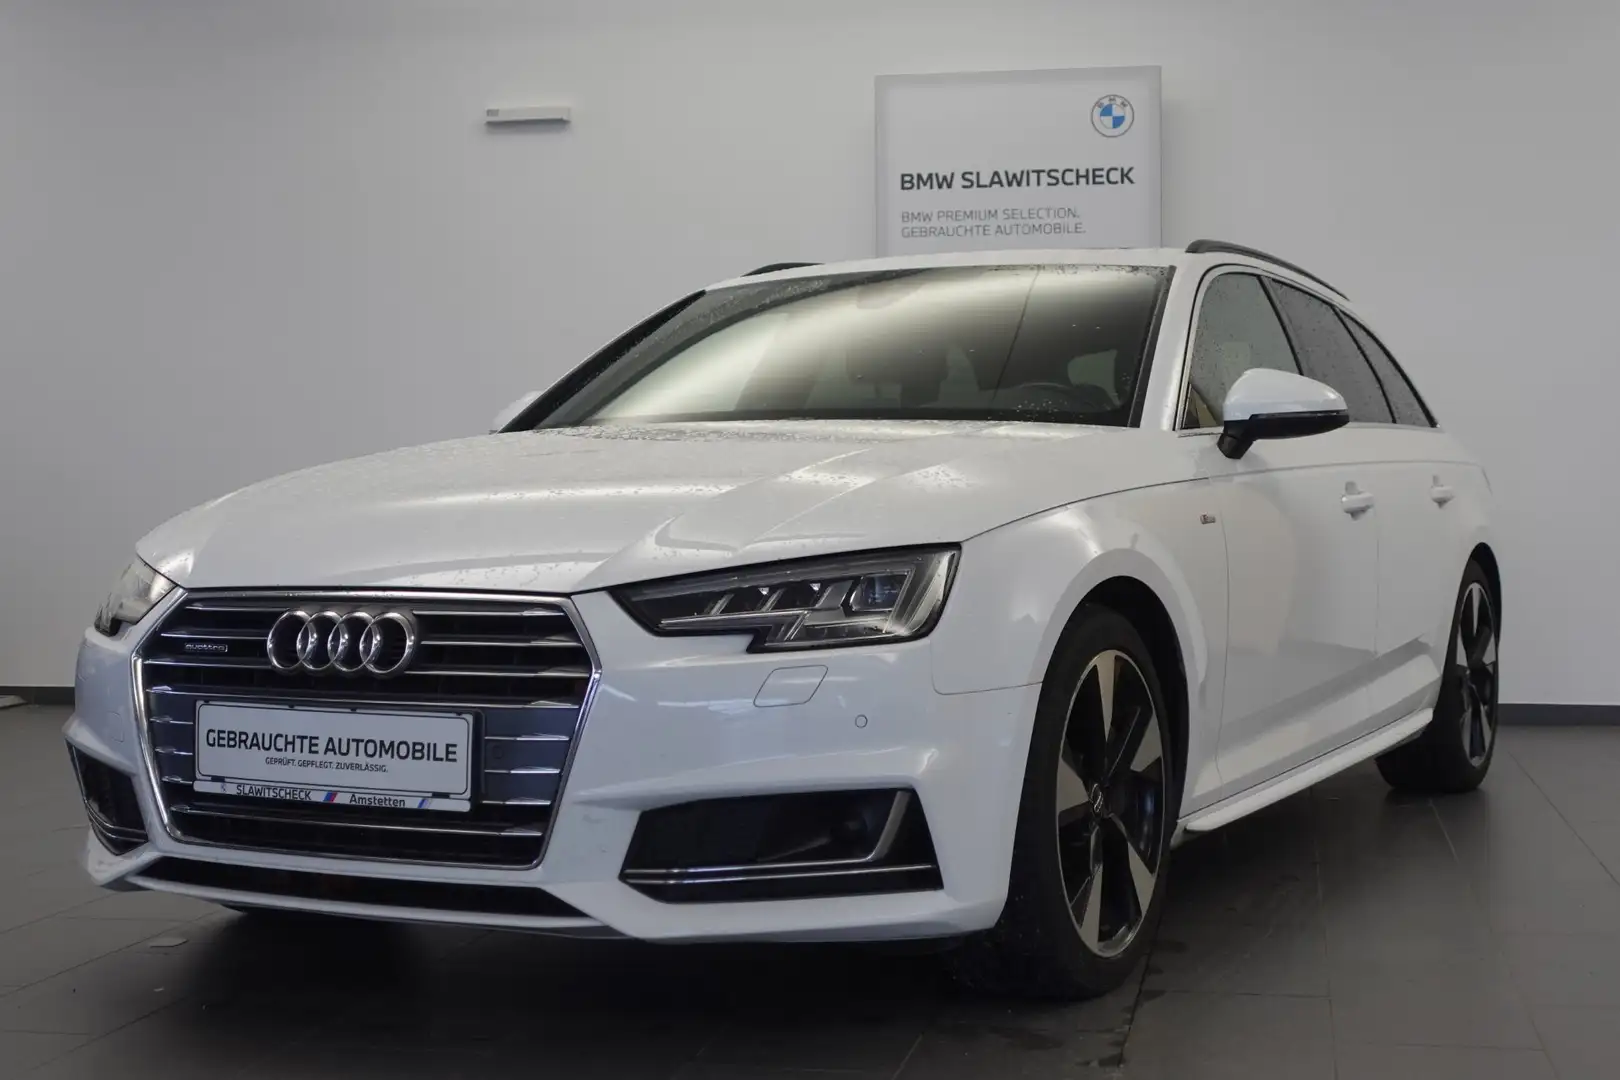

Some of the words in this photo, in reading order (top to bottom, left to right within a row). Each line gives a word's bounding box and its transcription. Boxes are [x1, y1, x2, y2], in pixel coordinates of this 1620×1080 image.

[900, 172, 954, 190] BMW
[961, 167, 1135, 189] SLAWITSCHECK
[901, 211, 933, 223] BMW
[937, 209, 998, 222] PREMIUM
[1003, 207, 1080, 220] SELECTION.
[901, 225, 991, 238] GEBRAUCHTE
[995, 222, 1086, 236] AUTOMOBILE.
[206, 728, 319, 755] GEBRAUCHTE
[324, 737, 458, 763] AUTOMOBILE
[236, 784, 312, 801] SLAWITSCHECK
[349, 794, 406, 808] Amstetten
